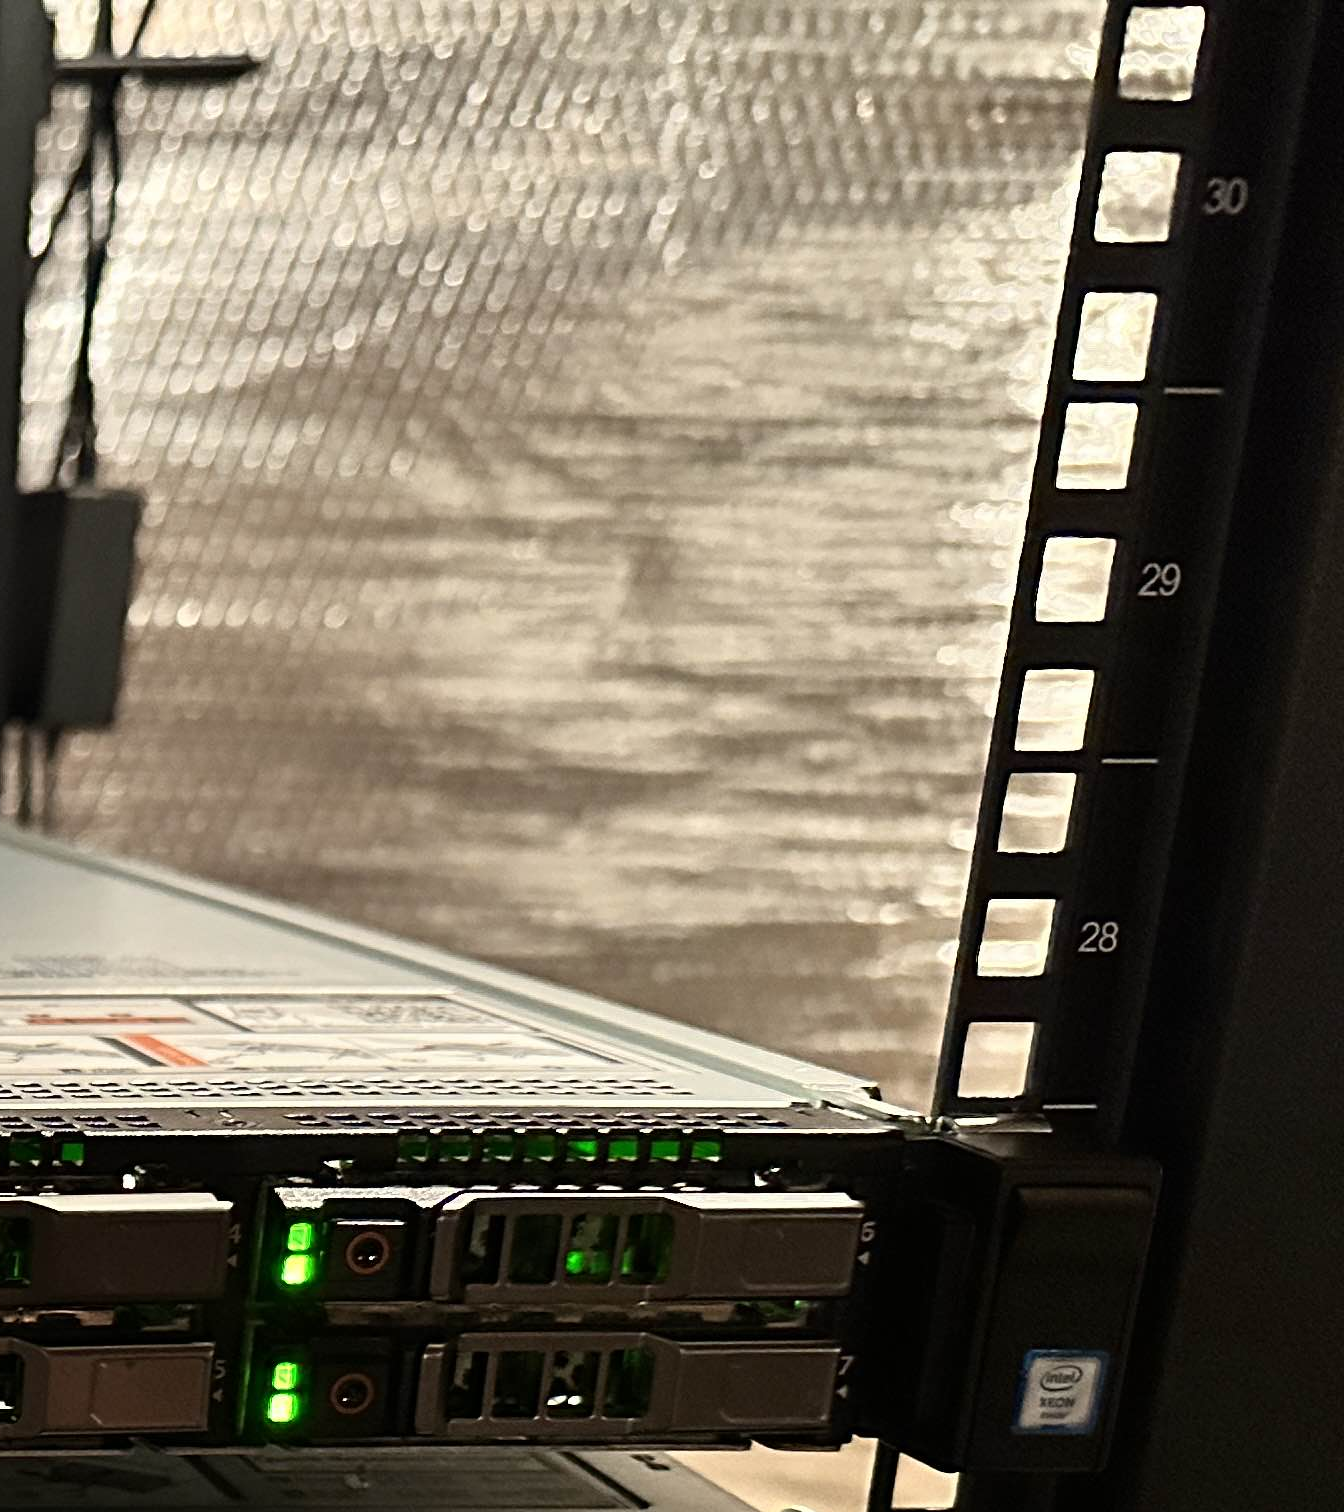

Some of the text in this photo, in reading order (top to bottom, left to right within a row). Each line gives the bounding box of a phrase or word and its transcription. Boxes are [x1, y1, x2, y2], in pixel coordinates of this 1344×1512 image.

[1203, 177, 1248, 215] 30
[1138, 562, 1181, 597] 29
[1078, 921, 1119, 953] 28
